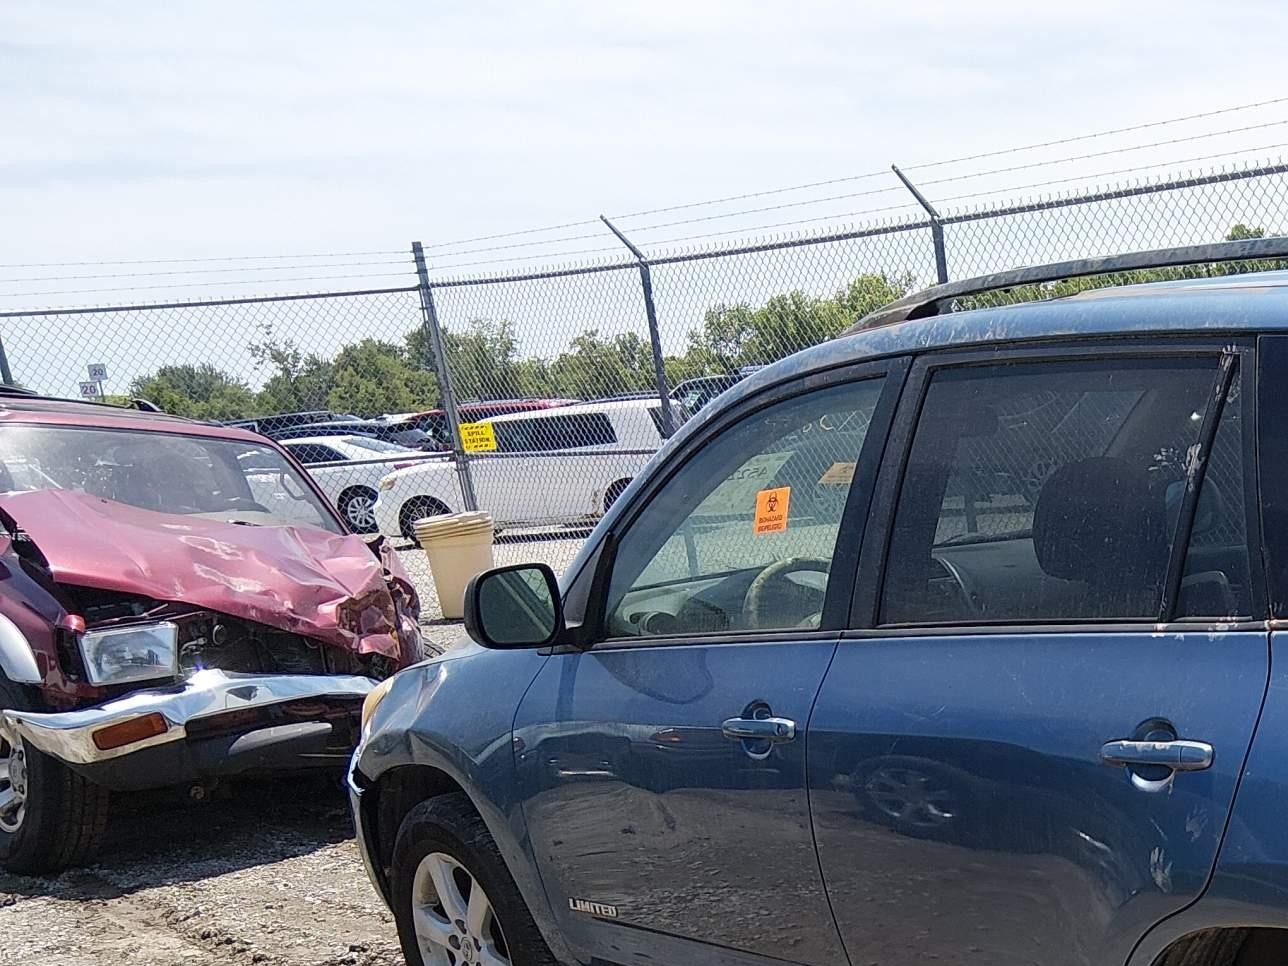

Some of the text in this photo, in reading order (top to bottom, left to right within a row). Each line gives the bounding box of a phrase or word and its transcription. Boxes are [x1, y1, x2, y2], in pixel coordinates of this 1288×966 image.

[92, 367, 104, 377] 20
[82, 385, 96, 395] 20
[568, 898, 617, 918] LIMITED
